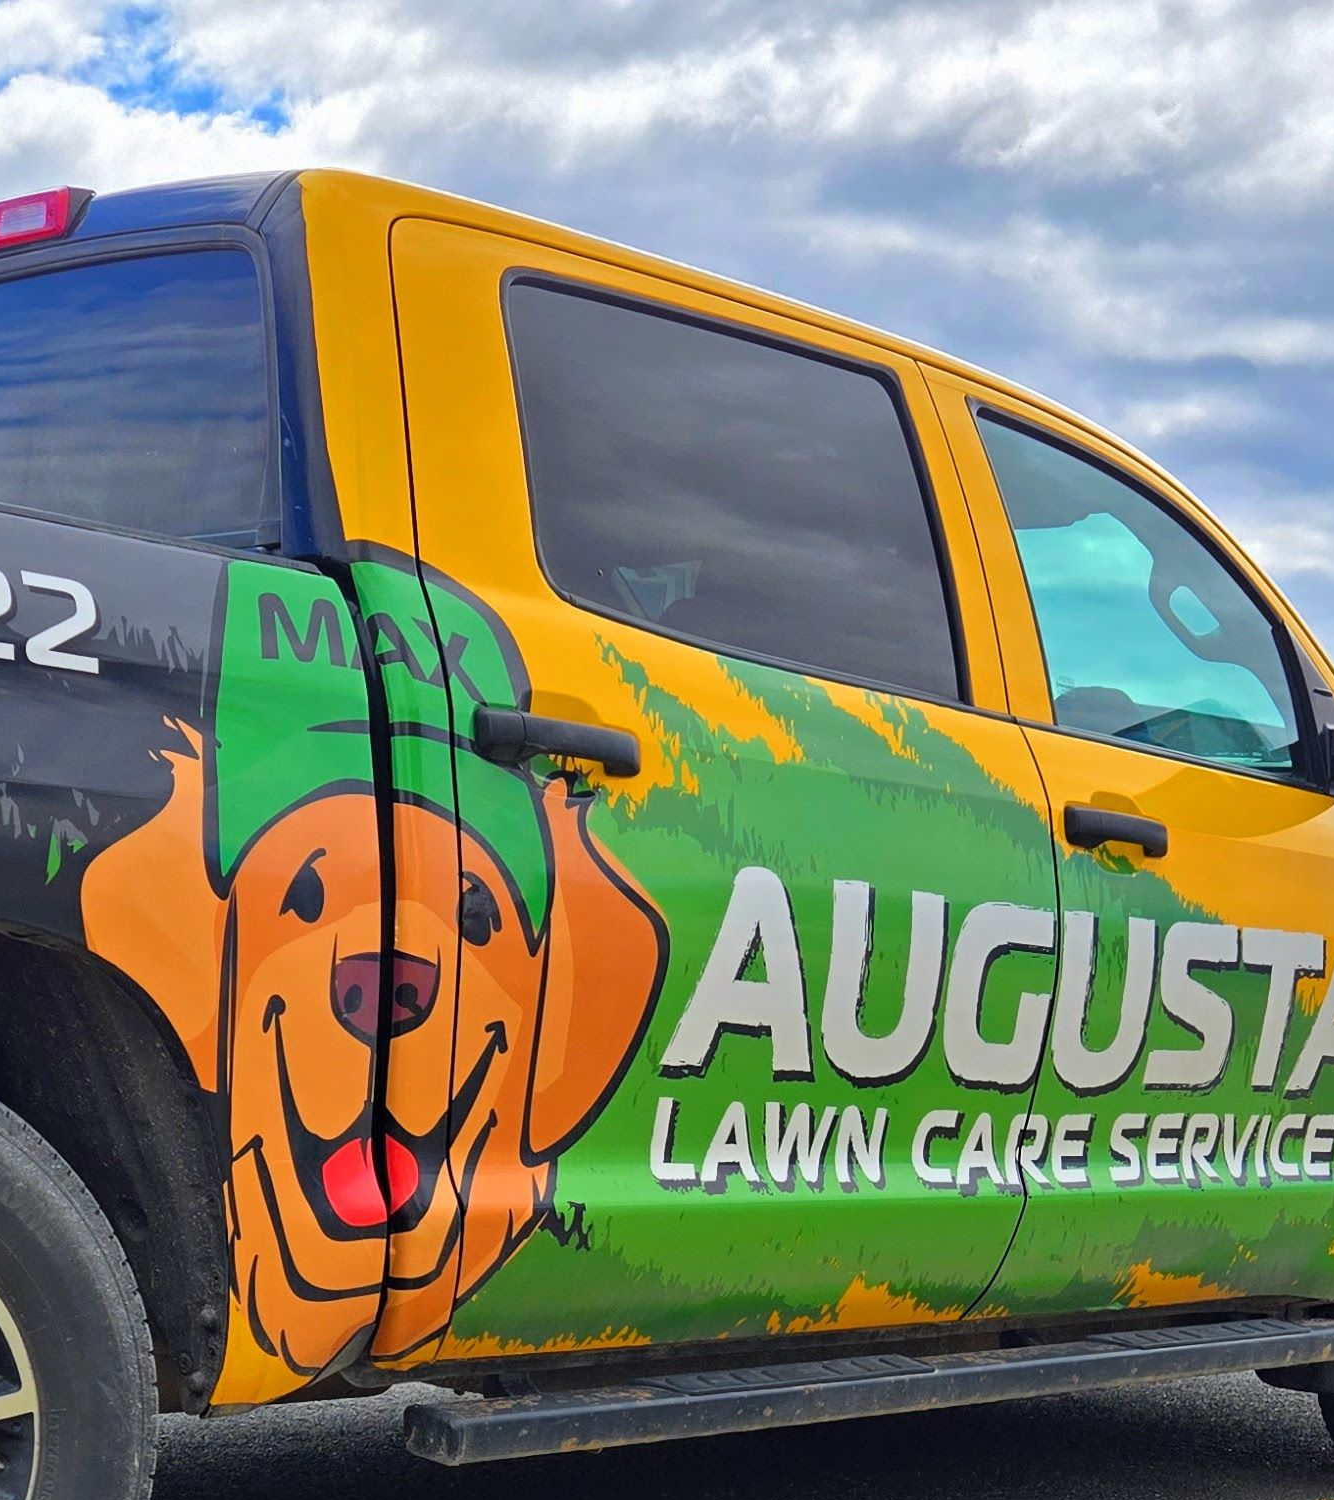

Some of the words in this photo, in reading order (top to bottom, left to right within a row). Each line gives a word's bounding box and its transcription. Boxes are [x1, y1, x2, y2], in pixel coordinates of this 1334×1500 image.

[256, 591, 487, 707] MAX
[648, 1096, 890, 1193] LAWN
[911, 1110, 1097, 1196] CARE
